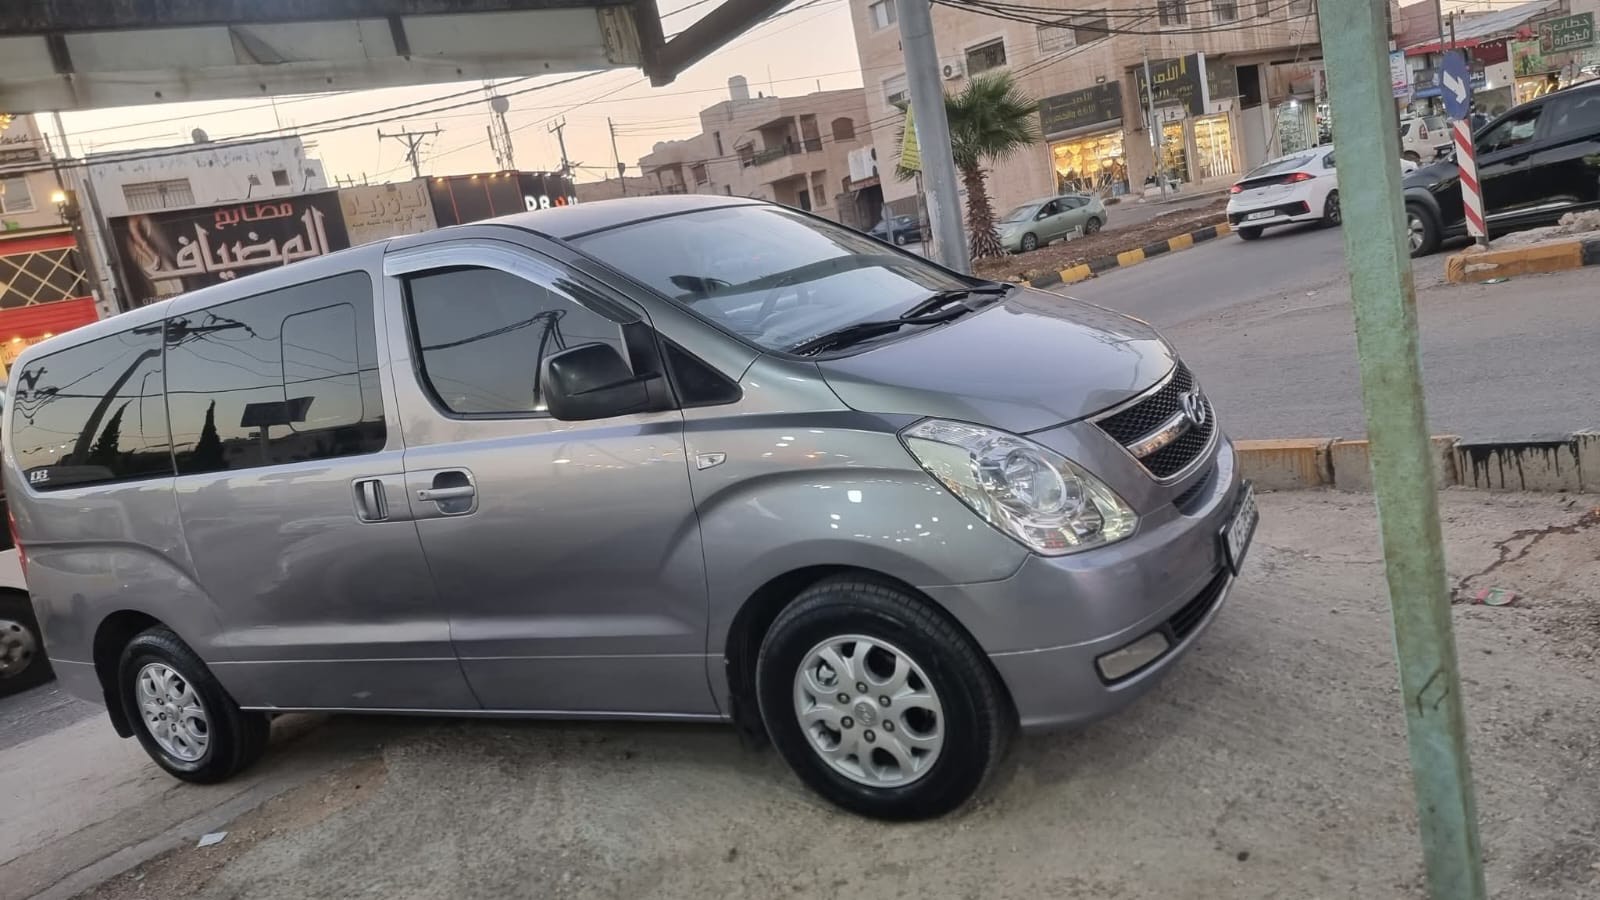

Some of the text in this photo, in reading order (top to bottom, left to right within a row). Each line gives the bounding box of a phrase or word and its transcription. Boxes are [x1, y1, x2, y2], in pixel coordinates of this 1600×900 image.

[214, 201, 293, 230] مطابخ
[347, 194, 386, 218] زياد
[143, 205, 330, 281] المضياف
